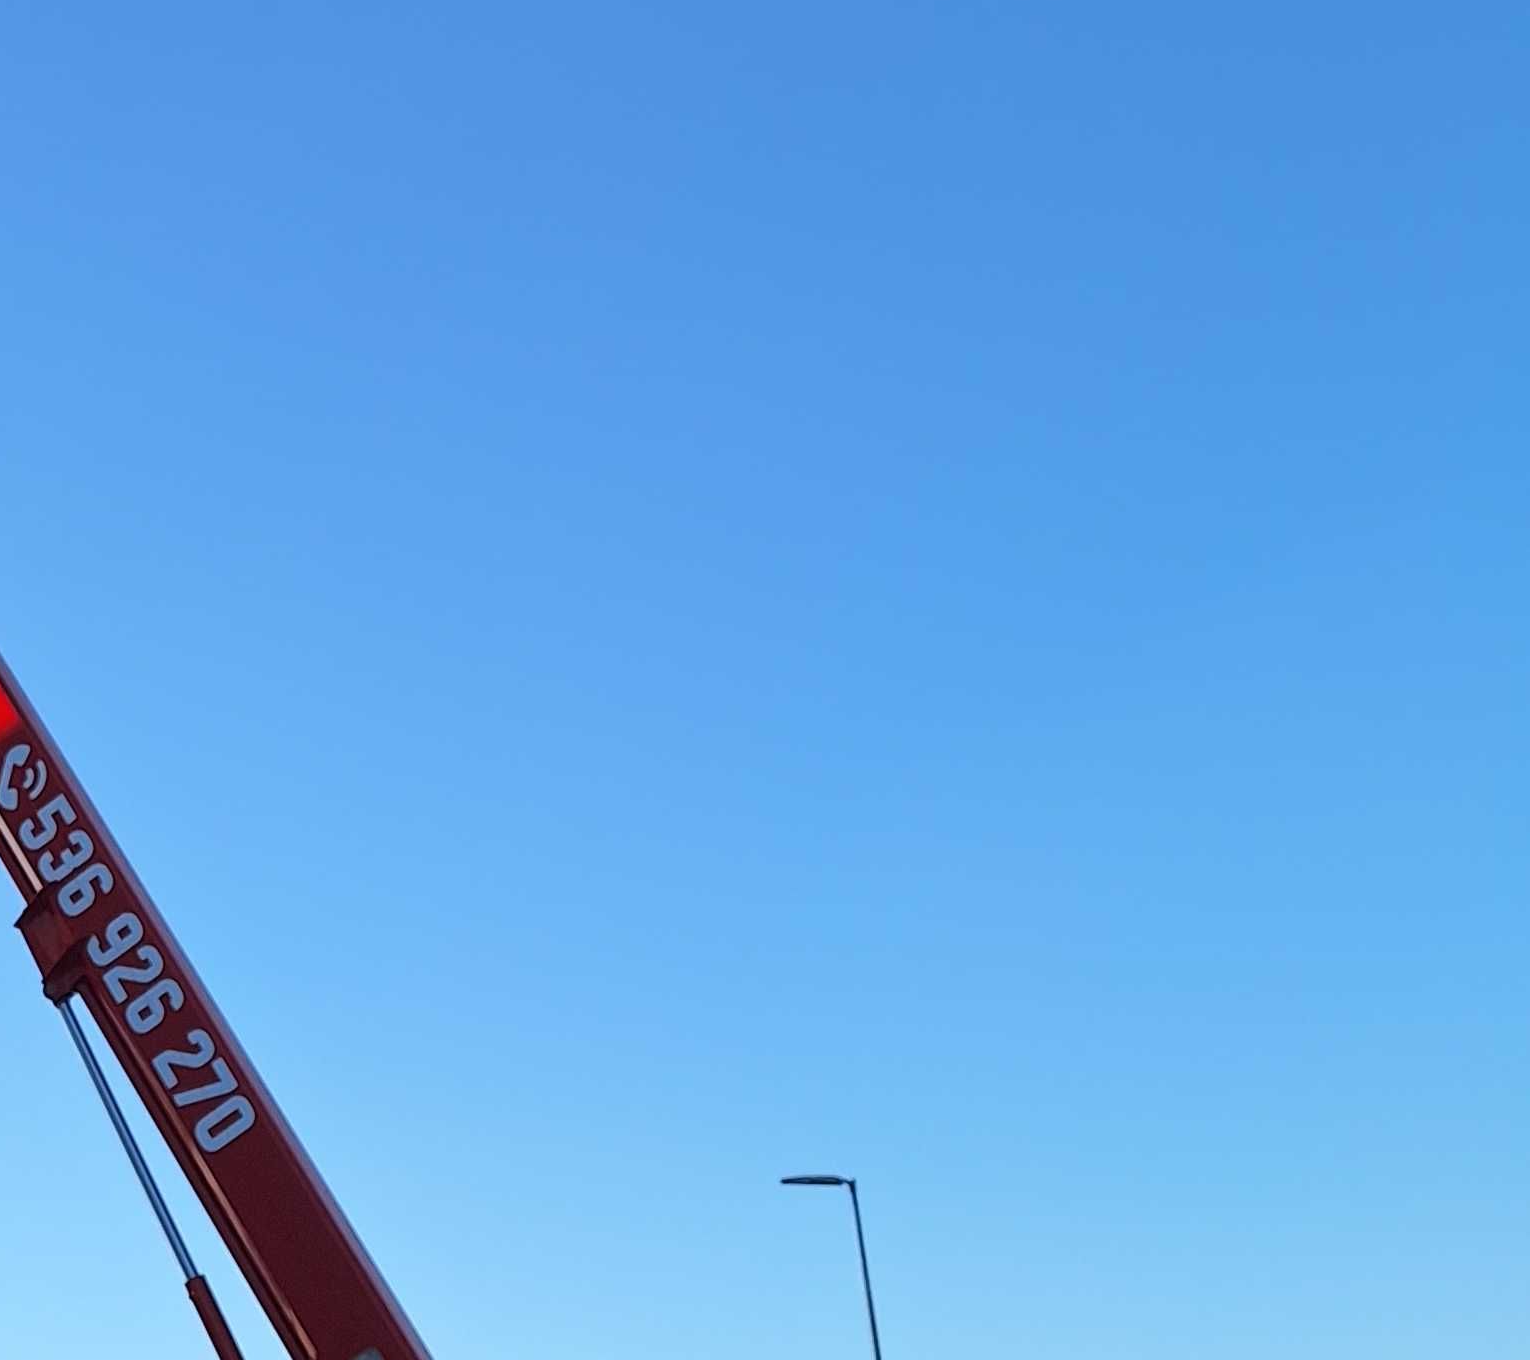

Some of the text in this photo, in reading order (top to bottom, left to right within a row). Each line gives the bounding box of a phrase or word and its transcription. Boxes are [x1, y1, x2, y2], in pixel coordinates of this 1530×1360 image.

[18, 793, 256, 1153] 536 926 270
